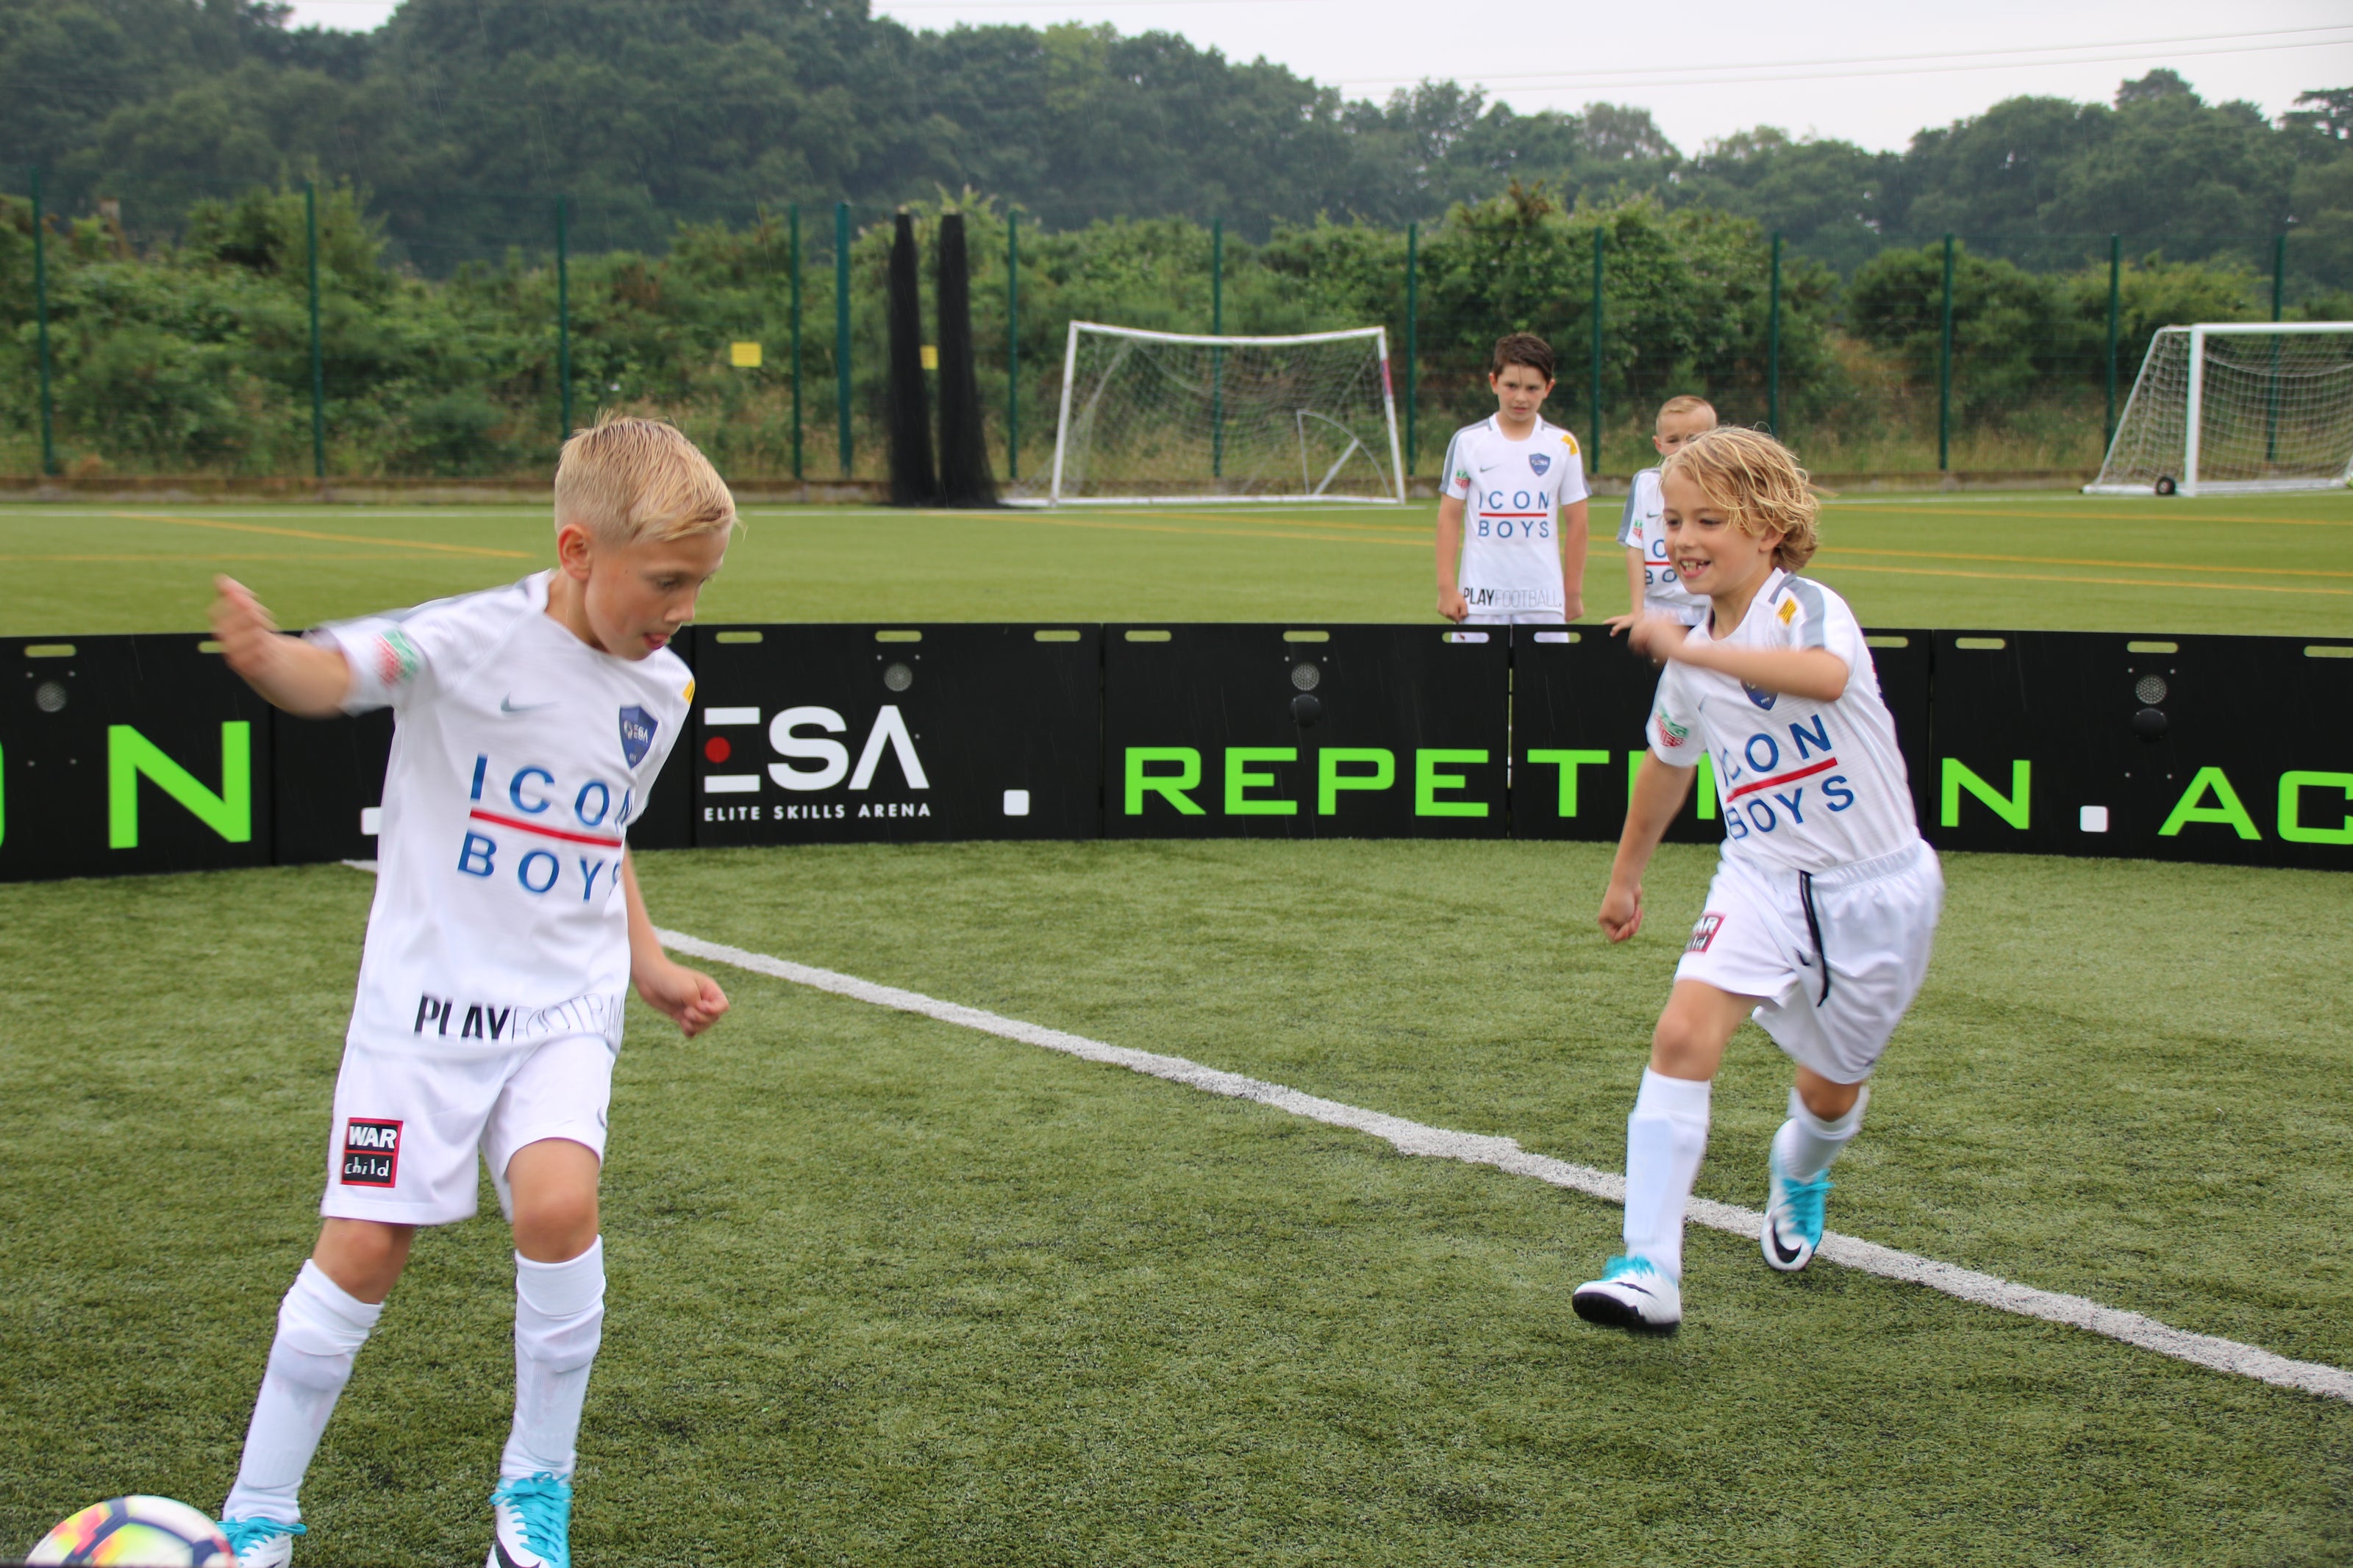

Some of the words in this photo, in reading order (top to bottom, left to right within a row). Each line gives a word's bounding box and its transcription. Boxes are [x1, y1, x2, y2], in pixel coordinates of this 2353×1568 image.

[1479, 491, 1549, 509] ICON
[1478, 520, 1549, 538] BOYS
[1644, 569, 1677, 585] BO
[0, 720, 251, 850] N
[704, 806, 761, 822] ELITE
[774, 803, 846, 820] SKILLS
[857, 802, 931, 818] ARENA
[1725, 774, 1854, 840] BOYS
[349, 1125, 398, 1149] WAR
[344, 1156, 390, 1177] child
